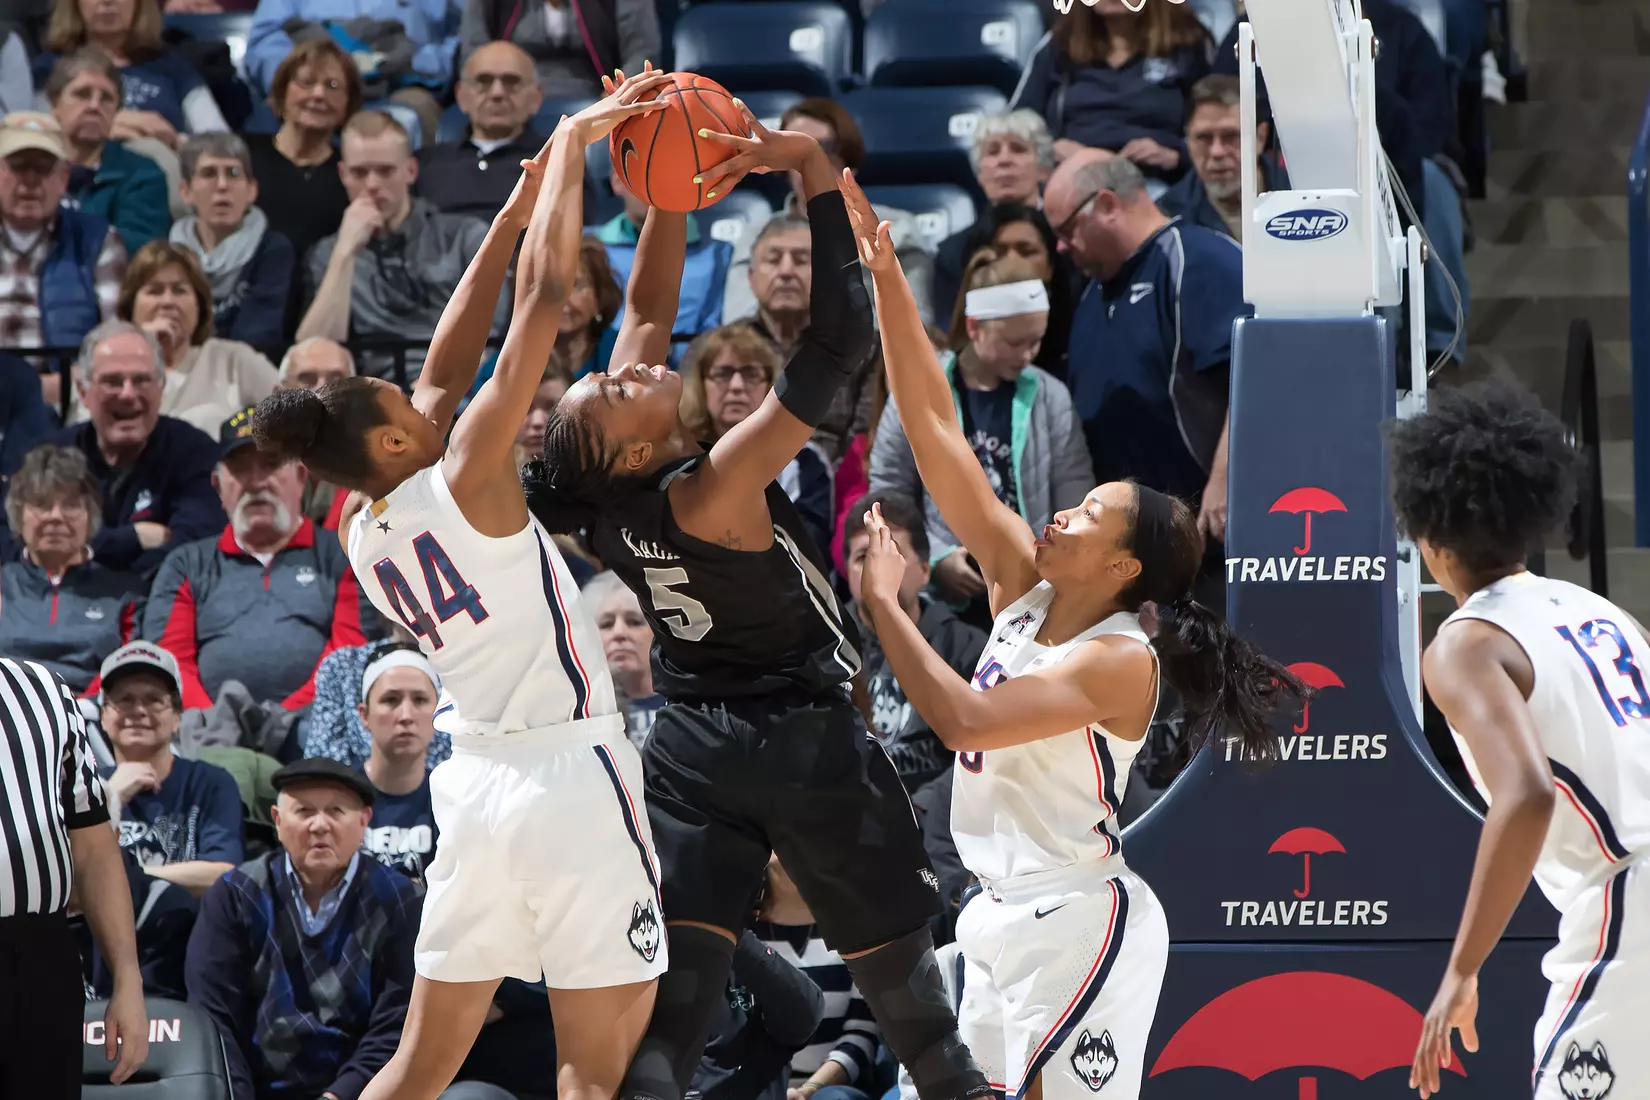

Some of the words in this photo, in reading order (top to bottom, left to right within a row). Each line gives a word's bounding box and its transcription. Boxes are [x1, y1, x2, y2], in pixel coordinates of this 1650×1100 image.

[1267, 216, 1341, 231] SNA
[1278, 229, 1330, 237] SPORTS
[1225, 556, 1387, 584] TRAVELERS
[372, 529, 490, 652] 44
[643, 566, 714, 642] 5
[1553, 618, 1650, 728] 13
[1220, 734, 1388, 762] TVELERS
[1220, 900, 1389, 926] TRAVELERS
